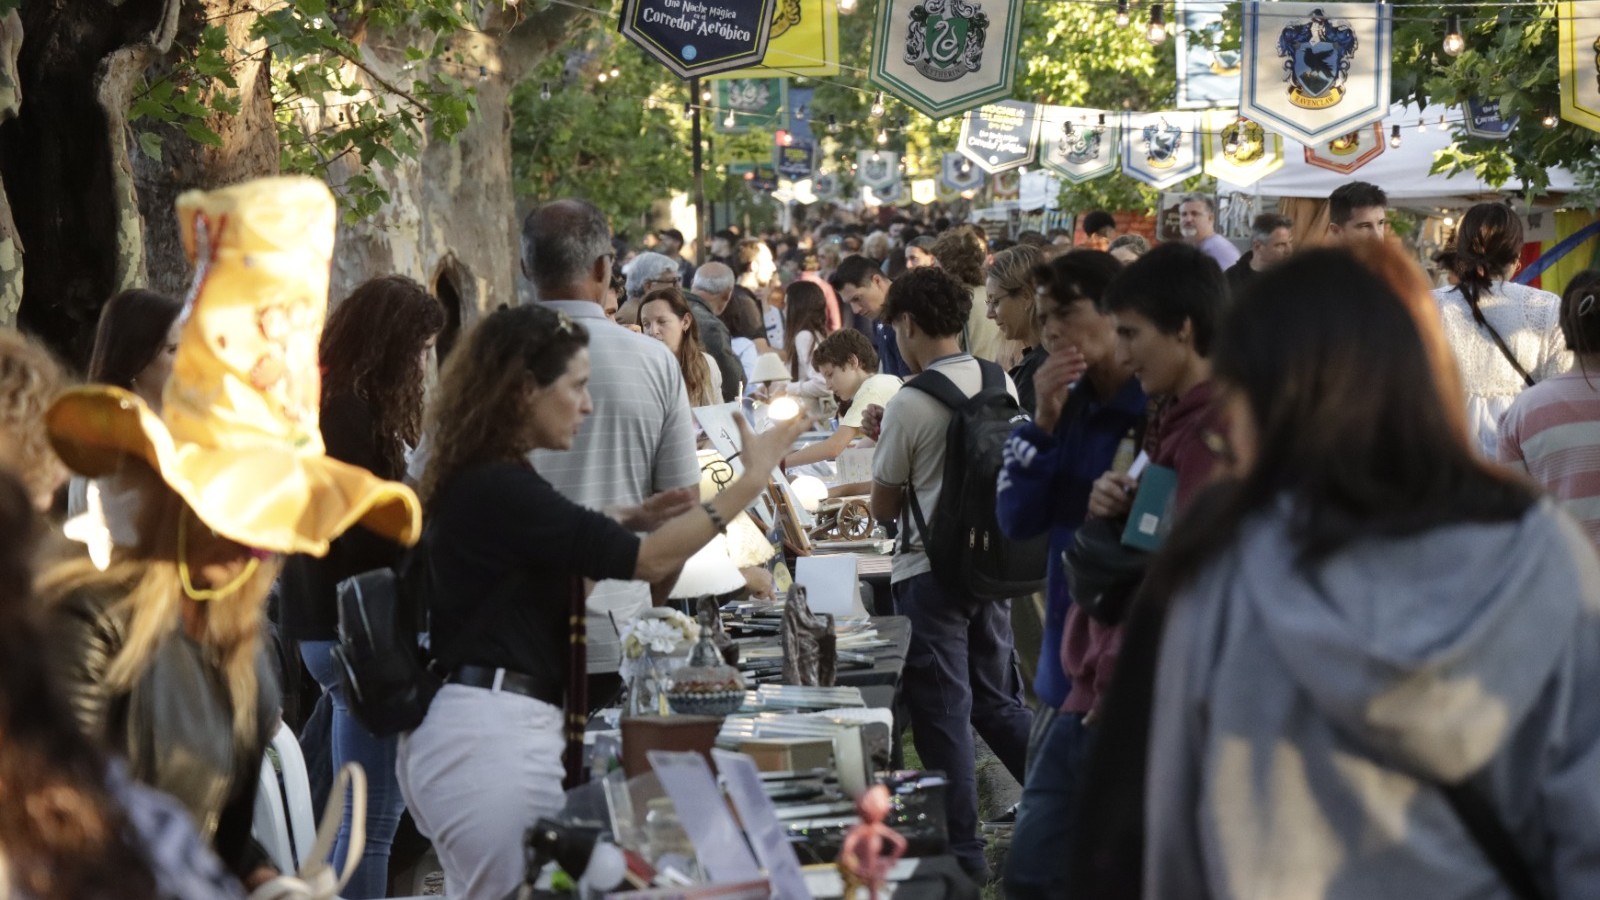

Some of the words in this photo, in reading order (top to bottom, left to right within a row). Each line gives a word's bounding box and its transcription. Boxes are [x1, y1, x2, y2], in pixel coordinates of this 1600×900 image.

[682, 0, 708, 14] Noche
[709, 6, 737, 20] Mágica
[643, 7, 697, 32] Corredor
[696, 21, 751, 42] Aeróbico
[1294, 95, 1334, 106] RAVENCLAW
